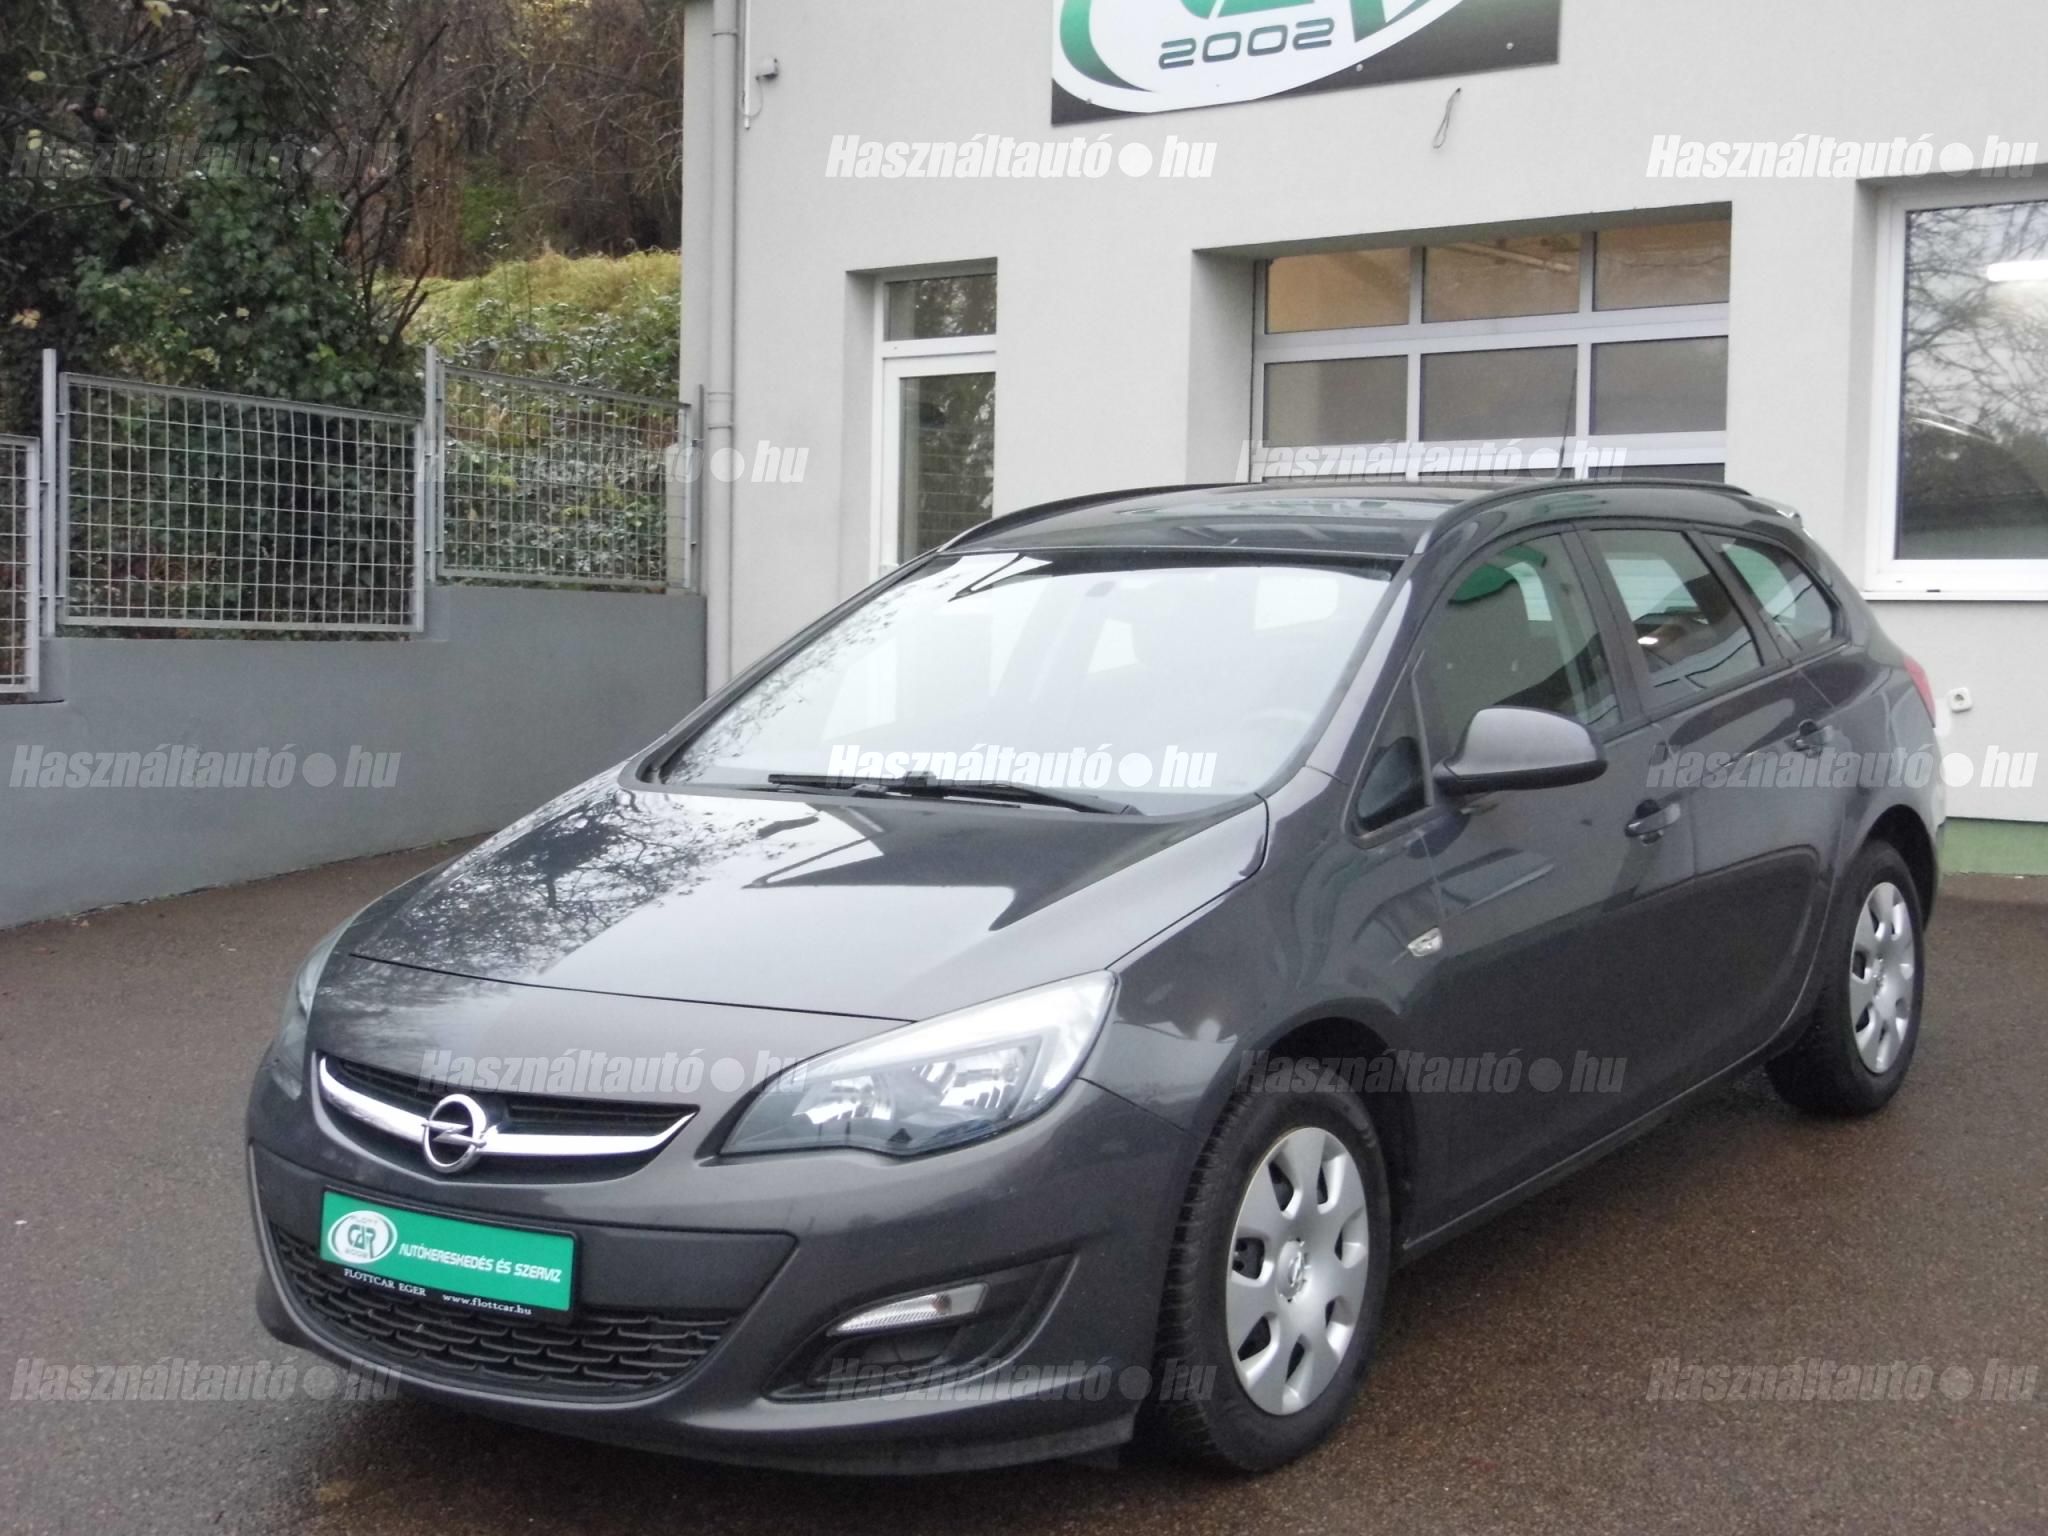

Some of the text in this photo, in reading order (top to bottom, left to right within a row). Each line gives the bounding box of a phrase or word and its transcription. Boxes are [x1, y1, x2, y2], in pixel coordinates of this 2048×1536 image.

[1158, 17, 1335, 70] 2002
[398, 1242, 562, 1283] AUTÓKERESKEDÉS ÉS SZERVIZ
[343, 1267, 427, 1297] FLOTTCAR EGER
[442, 1293, 533, 1316] www.flottcar.hu
